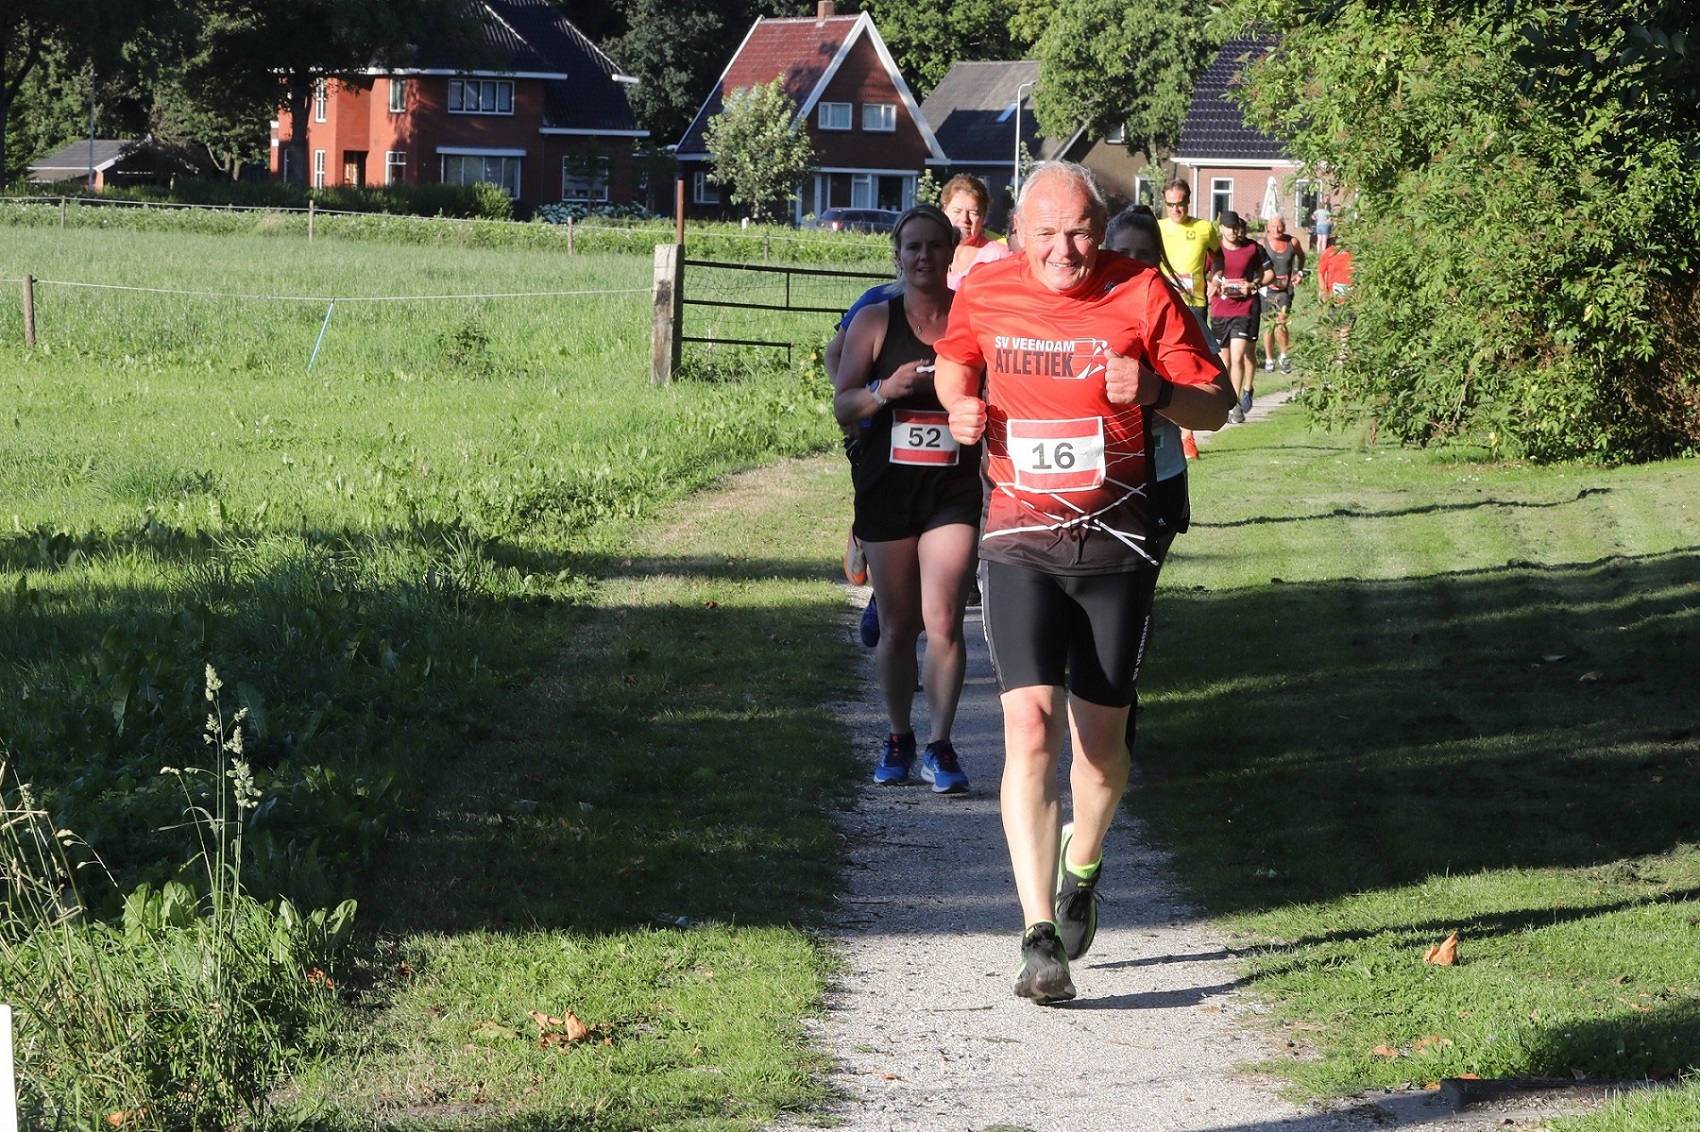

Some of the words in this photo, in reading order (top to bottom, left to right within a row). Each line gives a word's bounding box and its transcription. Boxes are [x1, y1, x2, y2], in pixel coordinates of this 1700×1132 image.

[995, 335, 1010, 349] SV
[1011, 337, 1076, 353] VEENDAM
[994, 348, 1075, 377] ATLETIEK
[908, 427, 942, 448] 52
[1032, 442, 1076, 470] 16
